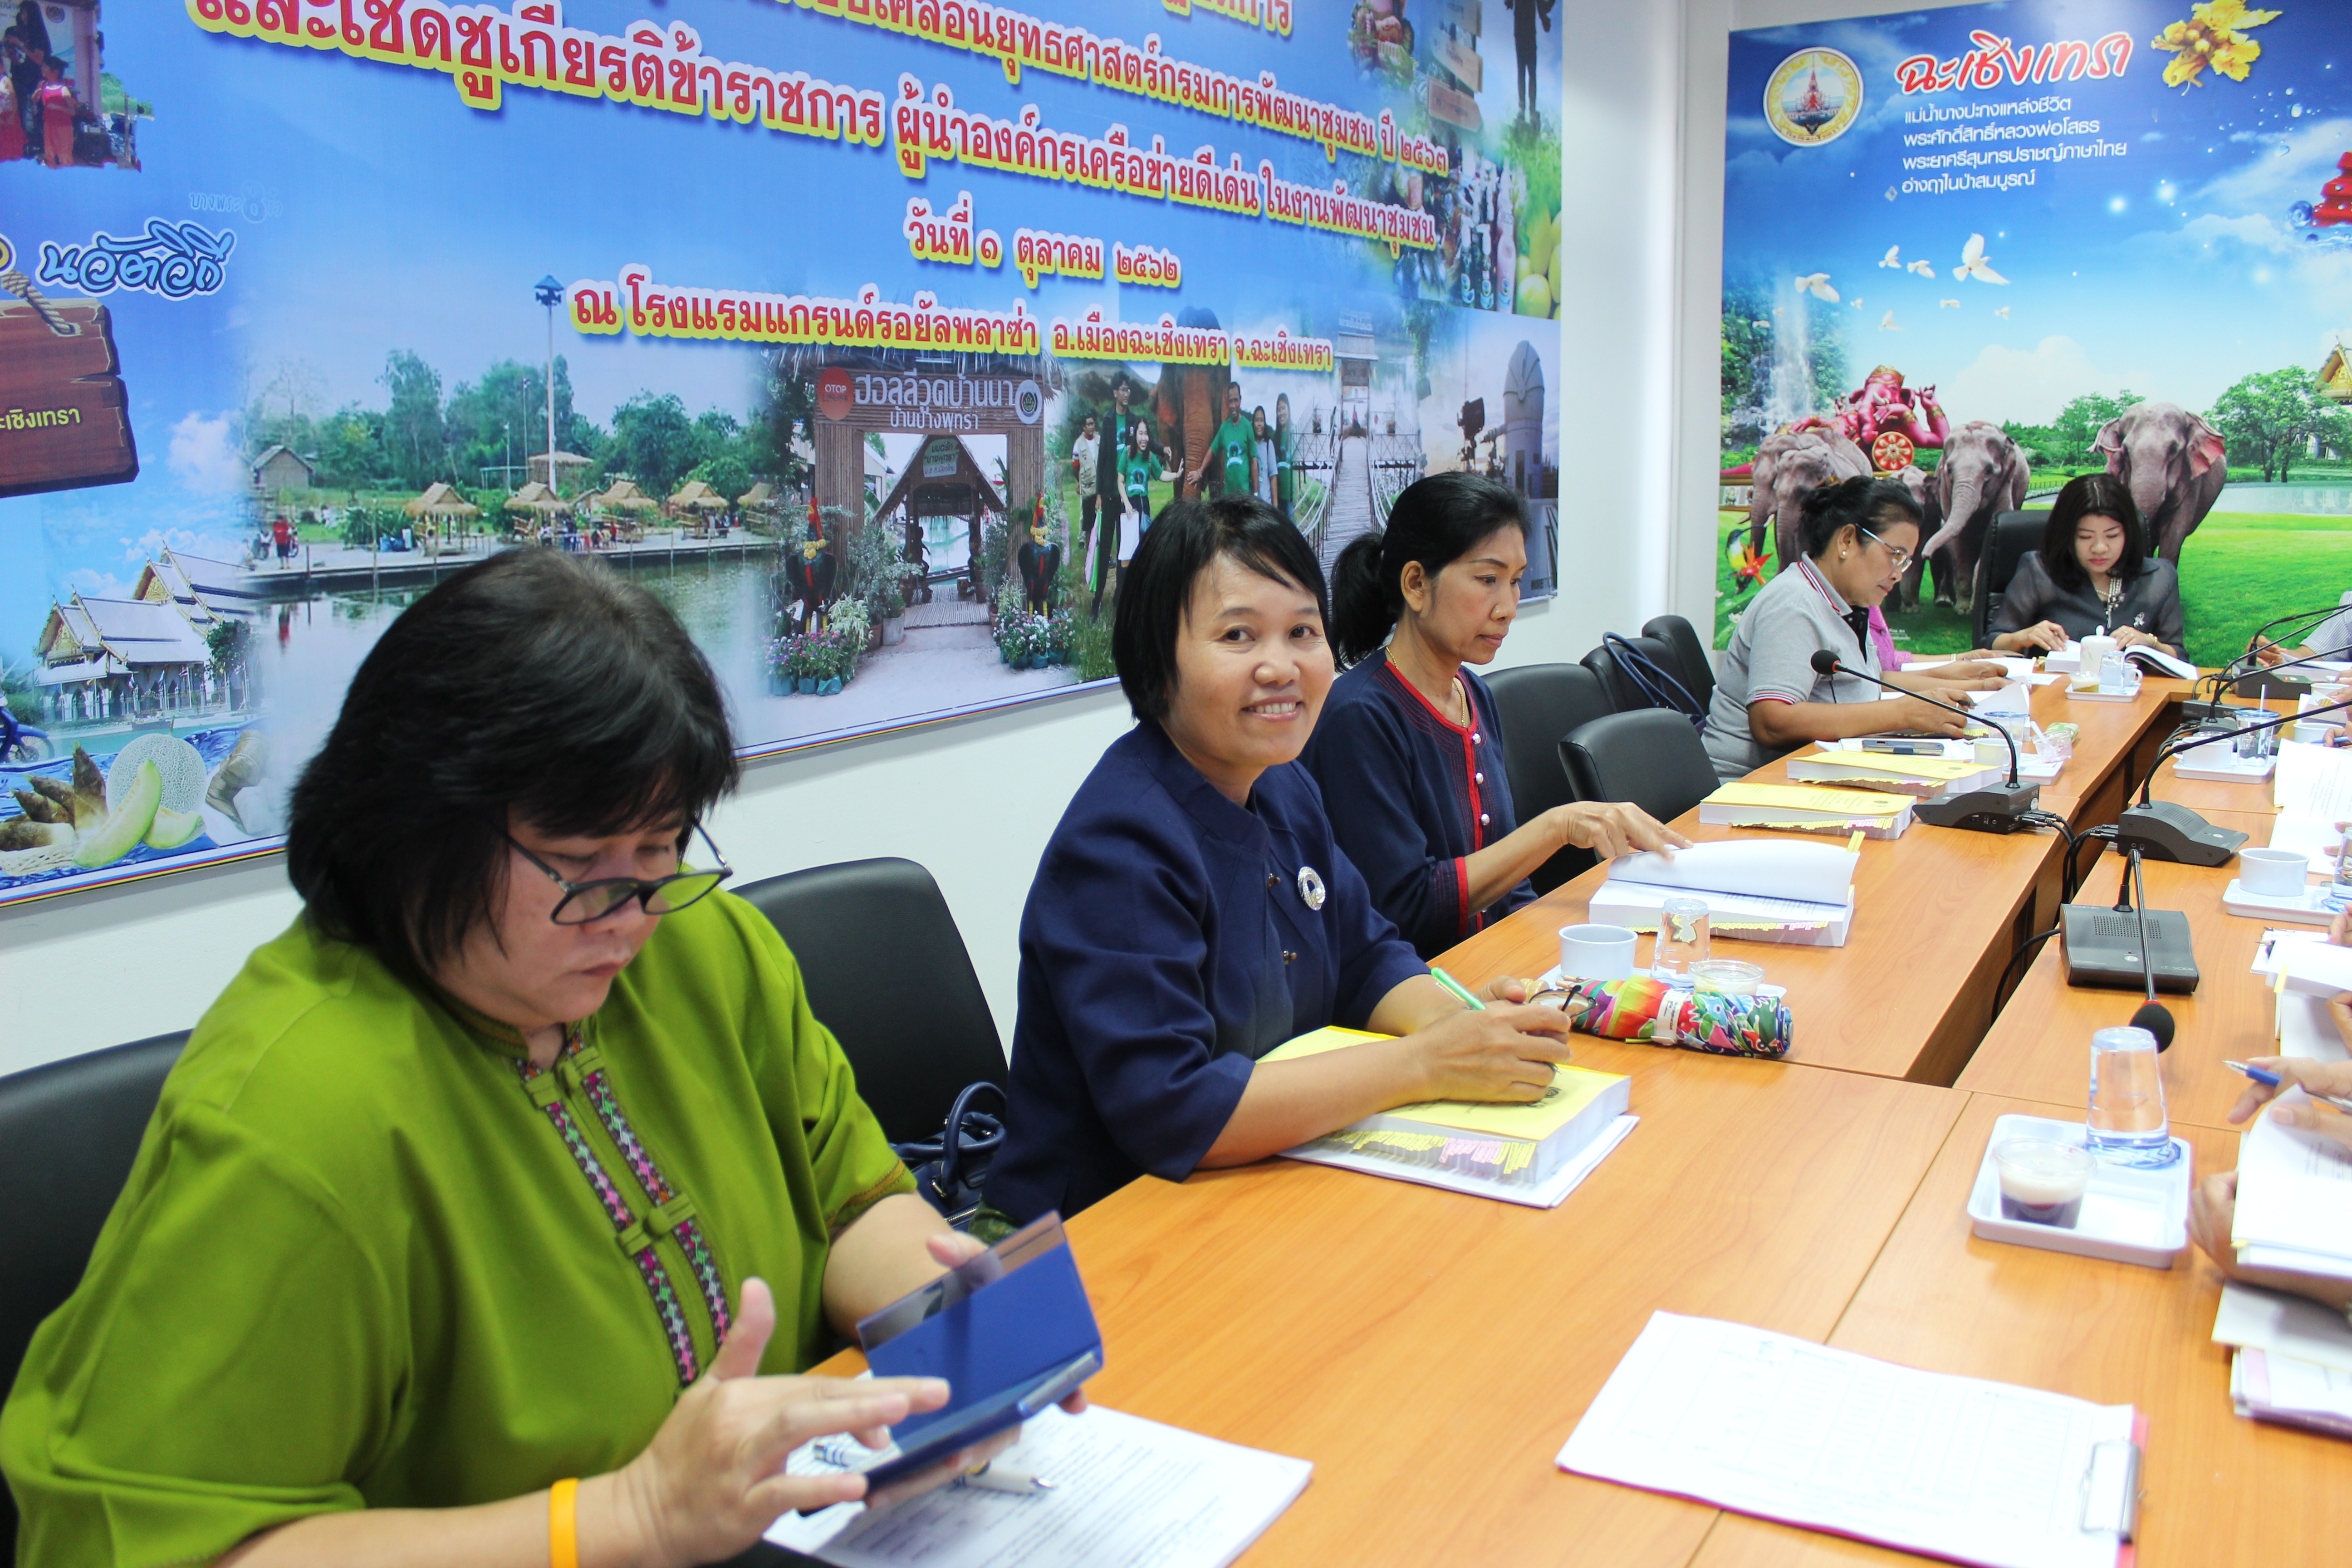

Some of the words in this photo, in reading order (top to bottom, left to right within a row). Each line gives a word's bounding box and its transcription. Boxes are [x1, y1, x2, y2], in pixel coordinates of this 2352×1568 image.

[1896, 30, 2133, 93] ฉะเชิงเทรา
[196, 0, 881, 138] ละเชดชูเกียรติข้าราชการ
[897, 82, 1258, 211] ผู้นำองค์กรเครือข่ายดีเด่น
[1262, 166, 1435, 250] ในงานพัฒนาชุมชน
[1904, 96, 2071, 124] แม่น้ำบางปะกงแหล่งชีวิต
[1380, 114, 1394, 157] ปี
[1400, 135, 1448, 172] ๒๕๖๓
[1903, 118, 2100, 147] พระศักดิ์สิทธิ์หลวงพ่อโสธร
[1902, 139, 2127, 171] พระยาศรีสุนทรปราชญ์ภาษาไทย
[908, 199, 969, 257] วันที่
[980, 237, 998, 260] ๑
[1017, 235, 1100, 281] ตุลาคม
[1116, 249, 1178, 282] ๒๕๖๒
[574, 289, 617, 325] ณ
[626, 273, 1036, 348] โรงแรมแกรนด์รอยัลพลาซ่า
[1053, 311, 1227, 359] อ.เมืองฉะเชิงเทรา
[1234, 330, 1332, 366] จ.ฉะเชิงเทรา
[825, 384, 847, 394] OTOP
[855, 367, 1014, 413] ฮอลลีวูดบ้านนา
[0, 408, 81, 431] ะเชิงเทรา
[890, 406, 979, 432] บ้านบางพุทรา
